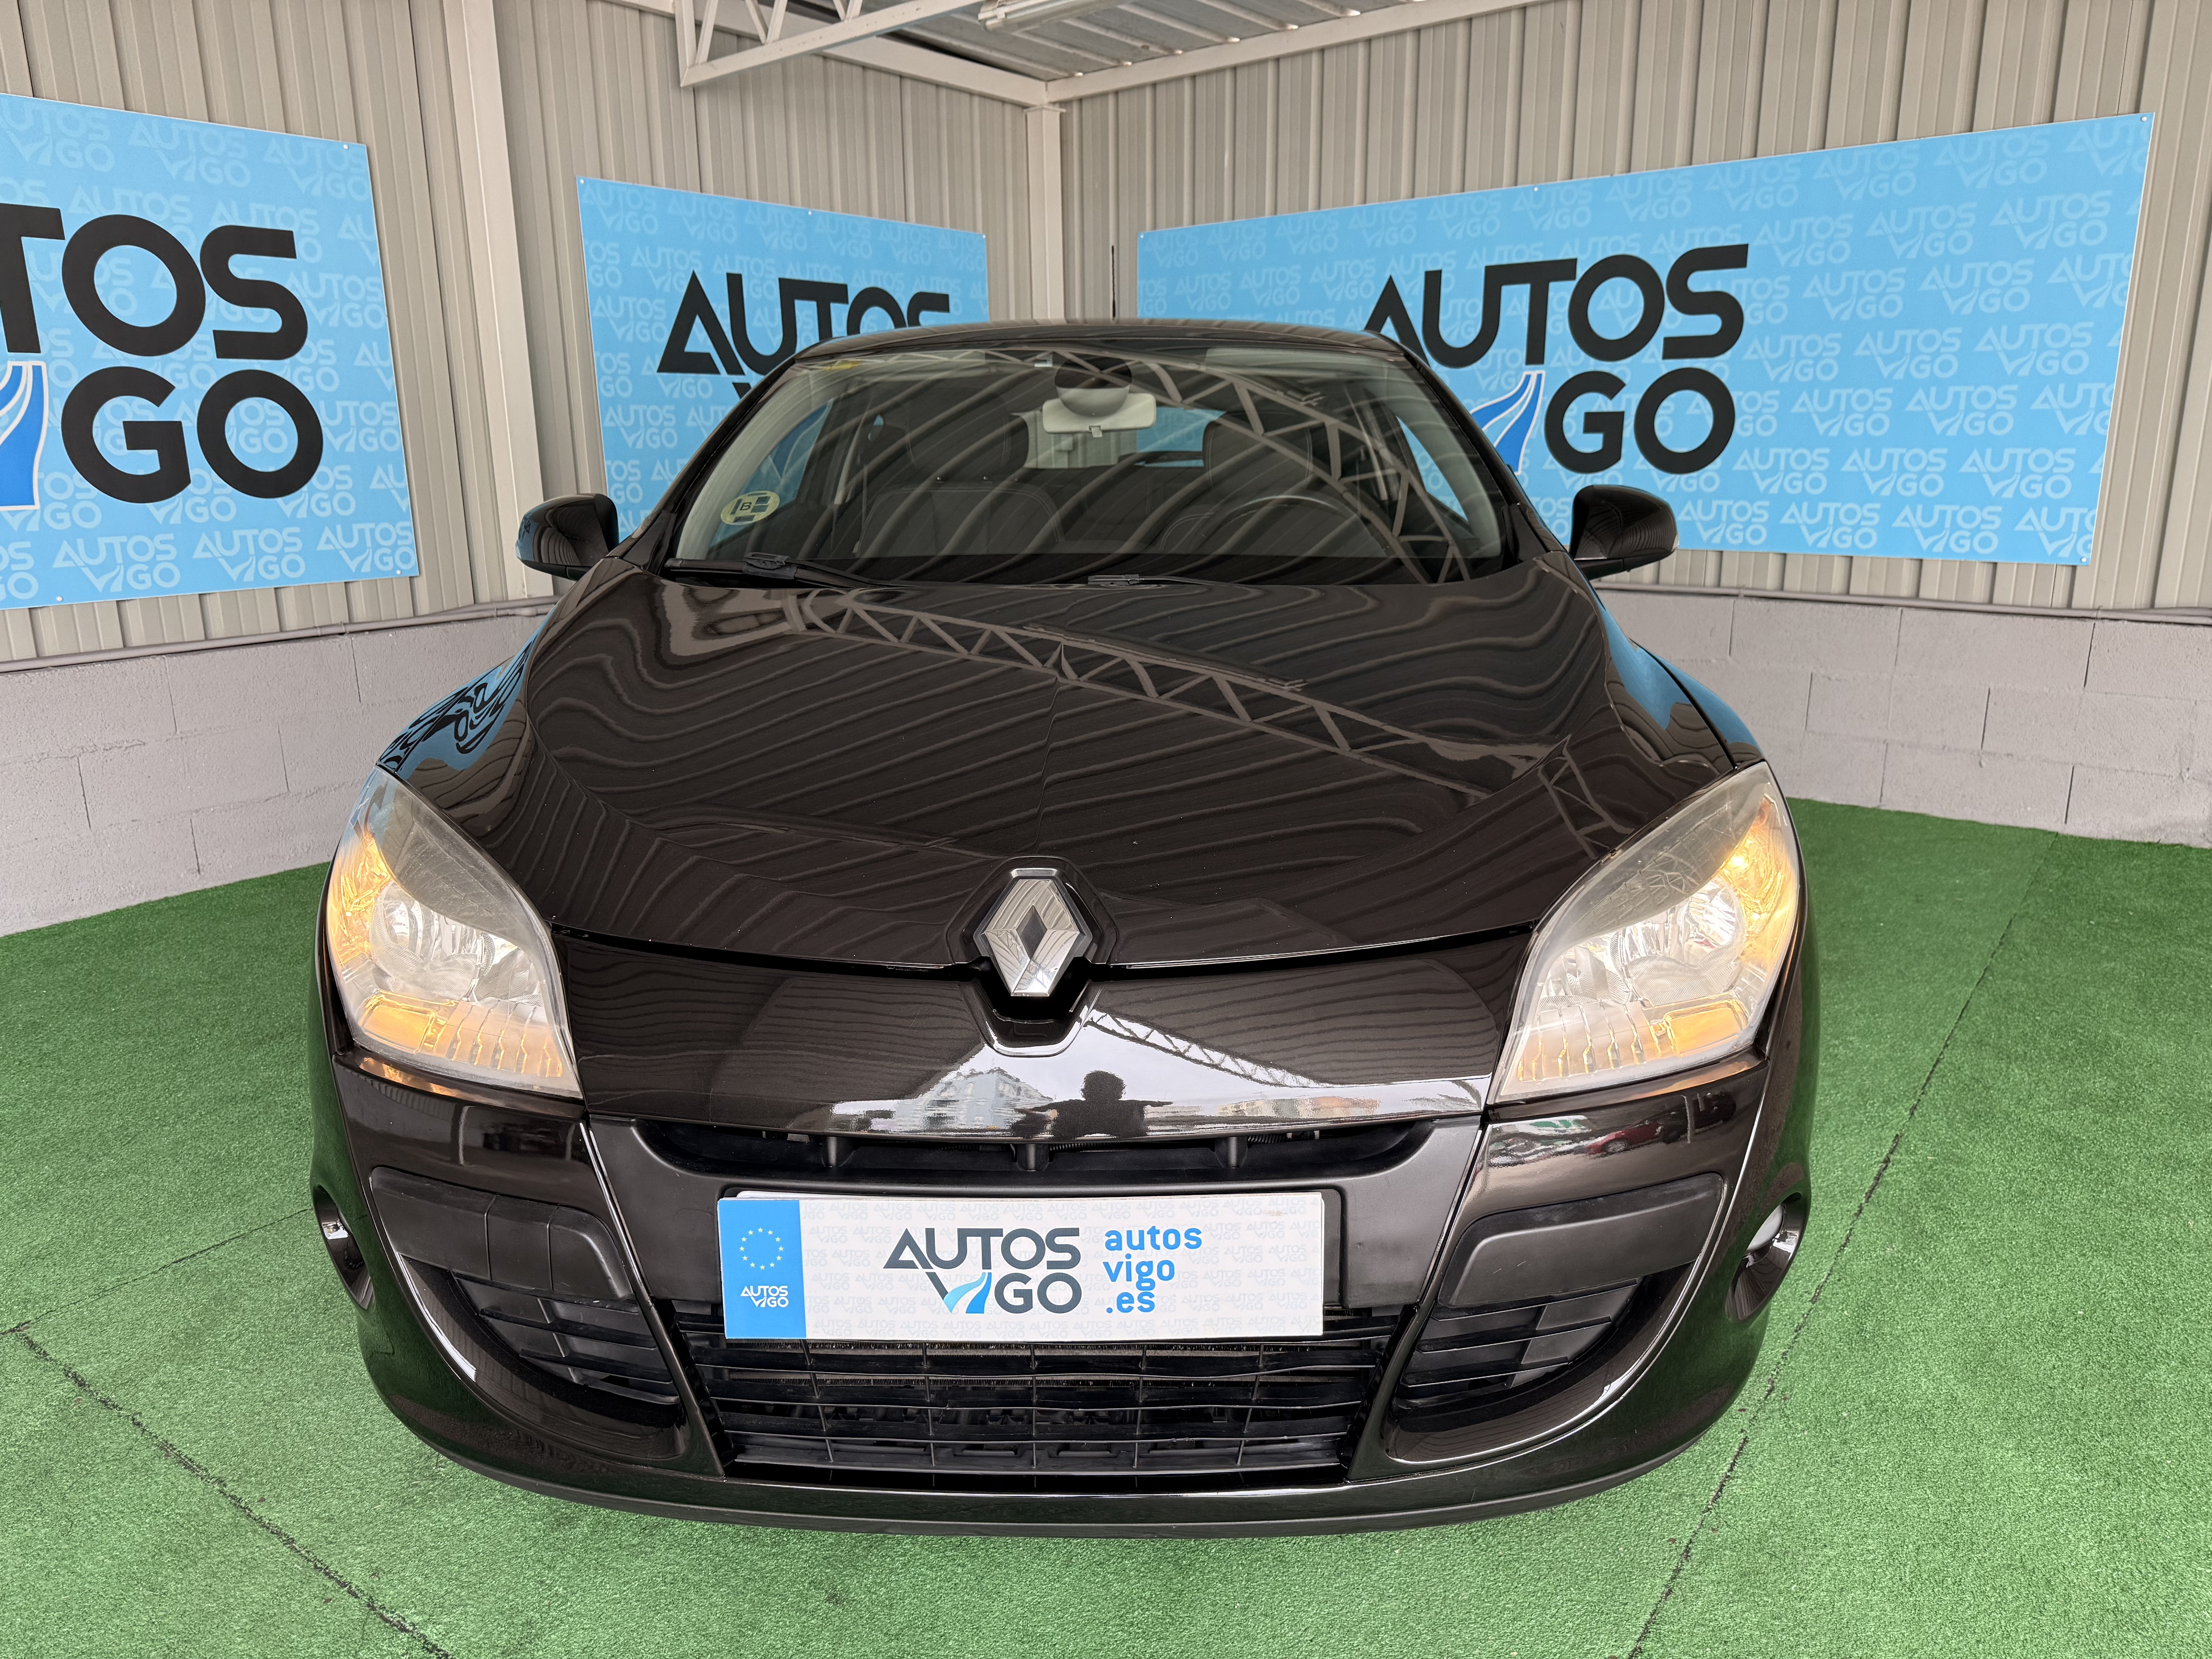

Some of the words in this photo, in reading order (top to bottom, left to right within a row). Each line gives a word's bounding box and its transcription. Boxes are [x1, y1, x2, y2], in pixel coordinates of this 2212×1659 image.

[1803, 267, 1907, 297] AUTOS
[1920, 258, 2035, 290] AUTOS
[307, 300, 388, 328] VIGO
[592, 294, 666, 319] AUTOS
[1743, 333, 1841, 359] AUTOS
[1853, 327, 1962, 355] AUTOS
[1975, 321, 2094, 350] AUTOS
[1763, 358, 1838, 382] VIGO
[1876, 354, 1958, 379] VIGO
[2000, 349, 2089, 376] VIGO
[658, 377, 712, 397] VIGO
[1792, 387, 1894, 412] AUTOS
[1906, 385, 2019, 410] AUTOS
[319, 400, 400, 426] UTOS
[604, 405, 676, 426] AUTOS
[1813, 413, 1890, 436] VIGO
[1930, 411, 2014, 435] VIGO
[325, 427, 403, 452] VIGO
[621, 428, 678, 449] VIGO
[1733, 448, 1829, 470] AUTOS
[1841, 448, 1947, 471] AUTOS
[1960, 448, 2076, 472] AUTOS
[1753, 472, 1826, 494] VIGO
[1863, 473, 1943, 496] VIGO
[1984, 474, 2071, 498] VIGO
[740, 502, 752, 511] B
[1678, 499, 1769, 521] AUTOS
[1781, 501, 1881, 525] AUTOS
[1893, 504, 2003, 528] AUTOS
[194, 526, 302, 558] AUTOS
[318, 520, 414, 550] AUTOS
[1697, 522, 1767, 544] VIGO
[1802, 526, 1877, 549] VIGO
[1916, 529, 1998, 553] VIGO
[55, 533, 177, 567] AUTOS
[341, 547, 417, 573] VIGO
[83, 562, 180, 592] VIGO
[220, 554, 306, 582] VIGO
[883, 1228, 1081, 1270] AUTOS
[1105, 1226, 1202, 1251] autos
[1103, 1254, 1175, 1291] vigo
[740, 1286, 788, 1297] AUTOS
[750, 1296, 789, 1307] VIGO
[925, 1272, 1082, 1314] VIGO
[1106, 1291, 1155, 1314] .es
